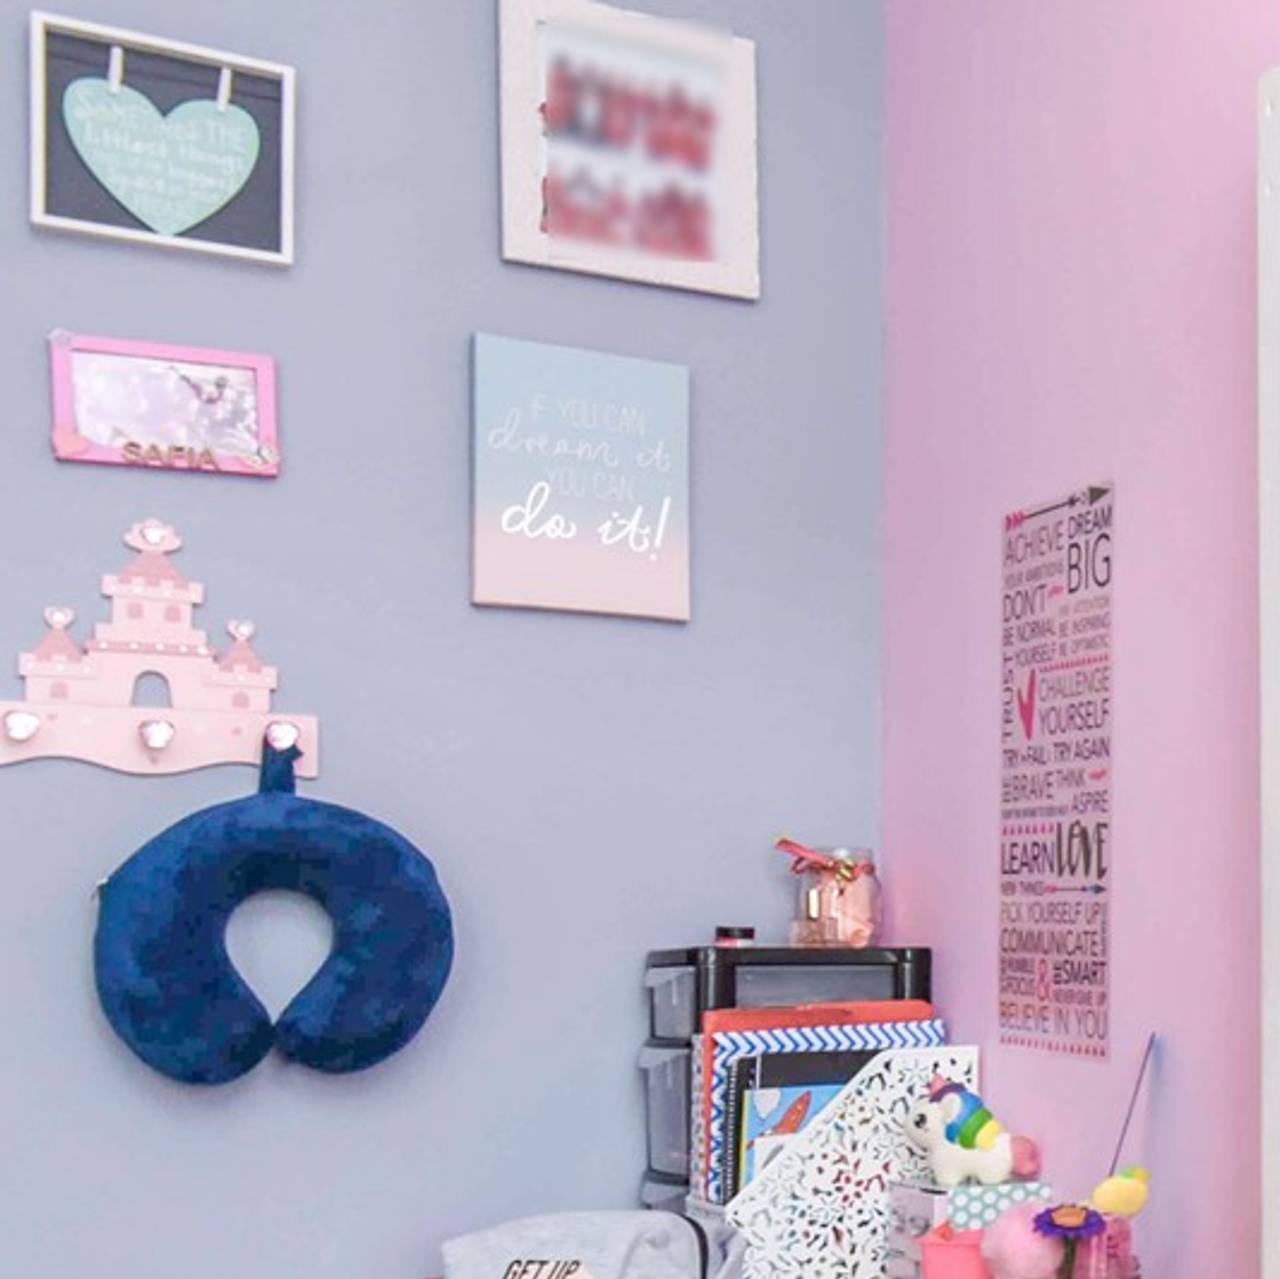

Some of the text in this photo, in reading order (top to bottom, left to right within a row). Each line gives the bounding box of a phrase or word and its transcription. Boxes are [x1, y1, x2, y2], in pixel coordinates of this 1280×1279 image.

[488, 406, 621, 468] dream
[123, 441, 221, 473] SAFIA
[501, 481, 672, 562] do it!
[1067, 504, 1112, 539] DREAM
[1005, 520, 1063, 563] ACHIEVE
[1068, 533, 1111, 594] BIG
[1039, 667, 1109, 703] CHALLENGE
[1039, 697, 1109, 736] YOURSELF
[1074, 736, 1110, 761] AGAIN
[1012, 771, 1054, 802] BRAVE
[1001, 841, 1055, 876] LEARN
[1055, 818, 1109, 880] LOVE
[1028, 901, 1082, 925] YOURSELF
[1000, 927, 1100, 957] COMMUNICATE
[1063, 958, 1108, 986] SMART
[1000, 1001, 1108, 1041] BELIEVE IN YOU
